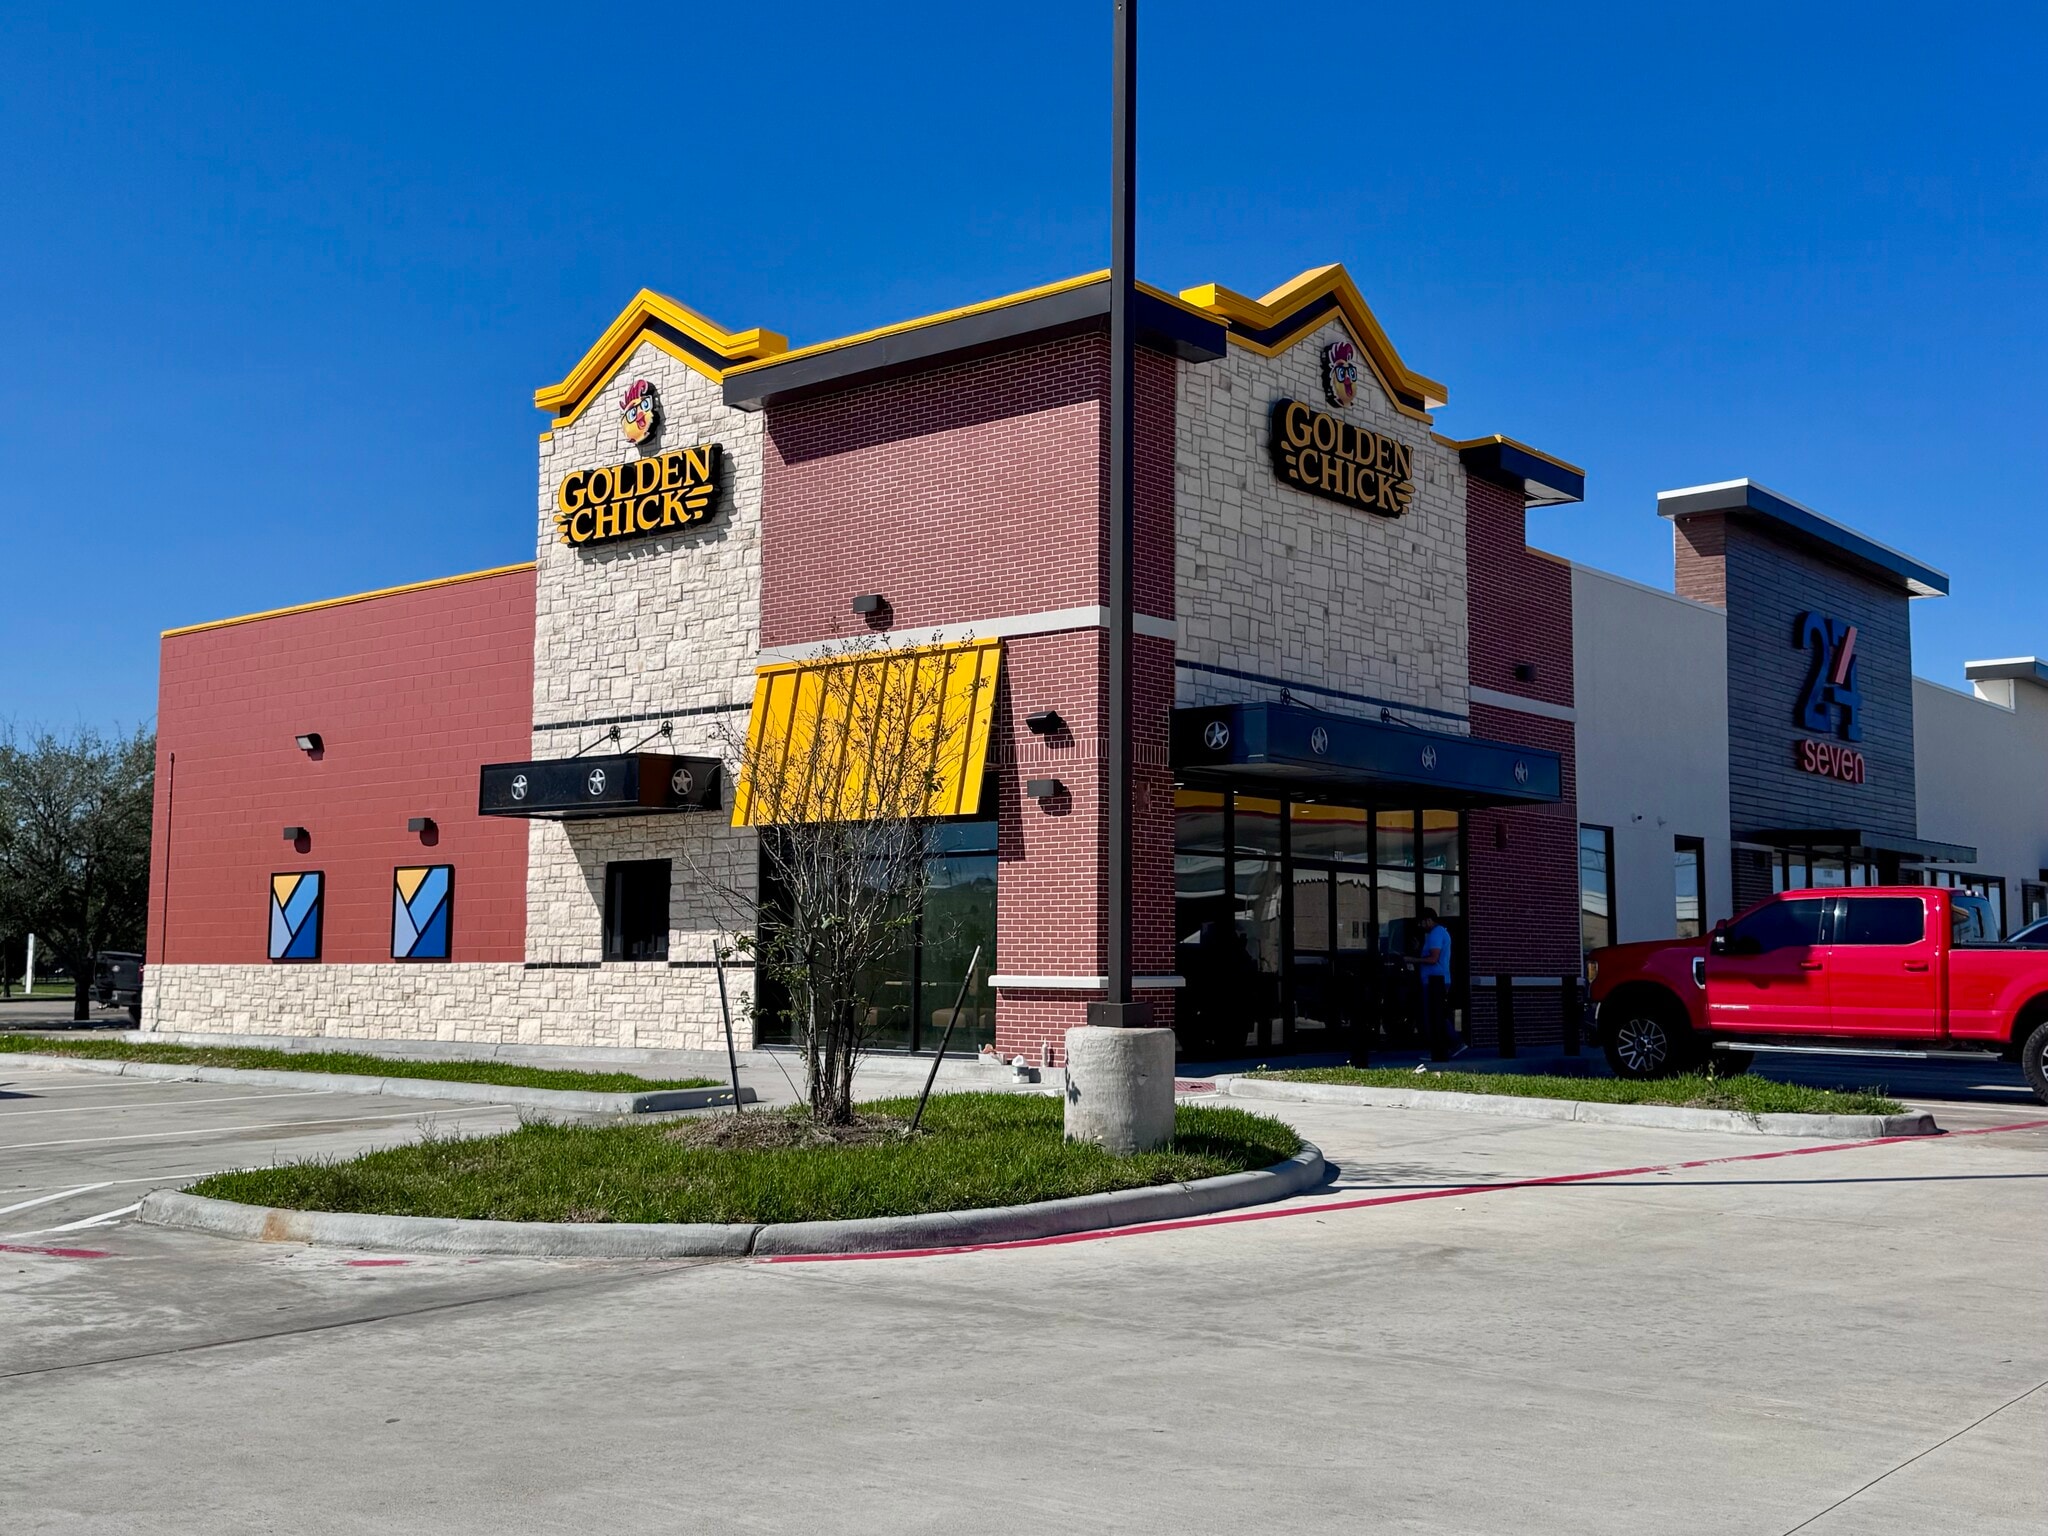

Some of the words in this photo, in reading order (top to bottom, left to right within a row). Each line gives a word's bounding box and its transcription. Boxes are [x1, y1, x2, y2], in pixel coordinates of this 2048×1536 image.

[1286, 401, 1413, 481] GOLDEN
[558, 444, 713, 514] GOLDEN
[1298, 449, 1401, 512] CHICK
[570, 487, 693, 543] CHICK
[1804, 739, 1866, 784] seven
